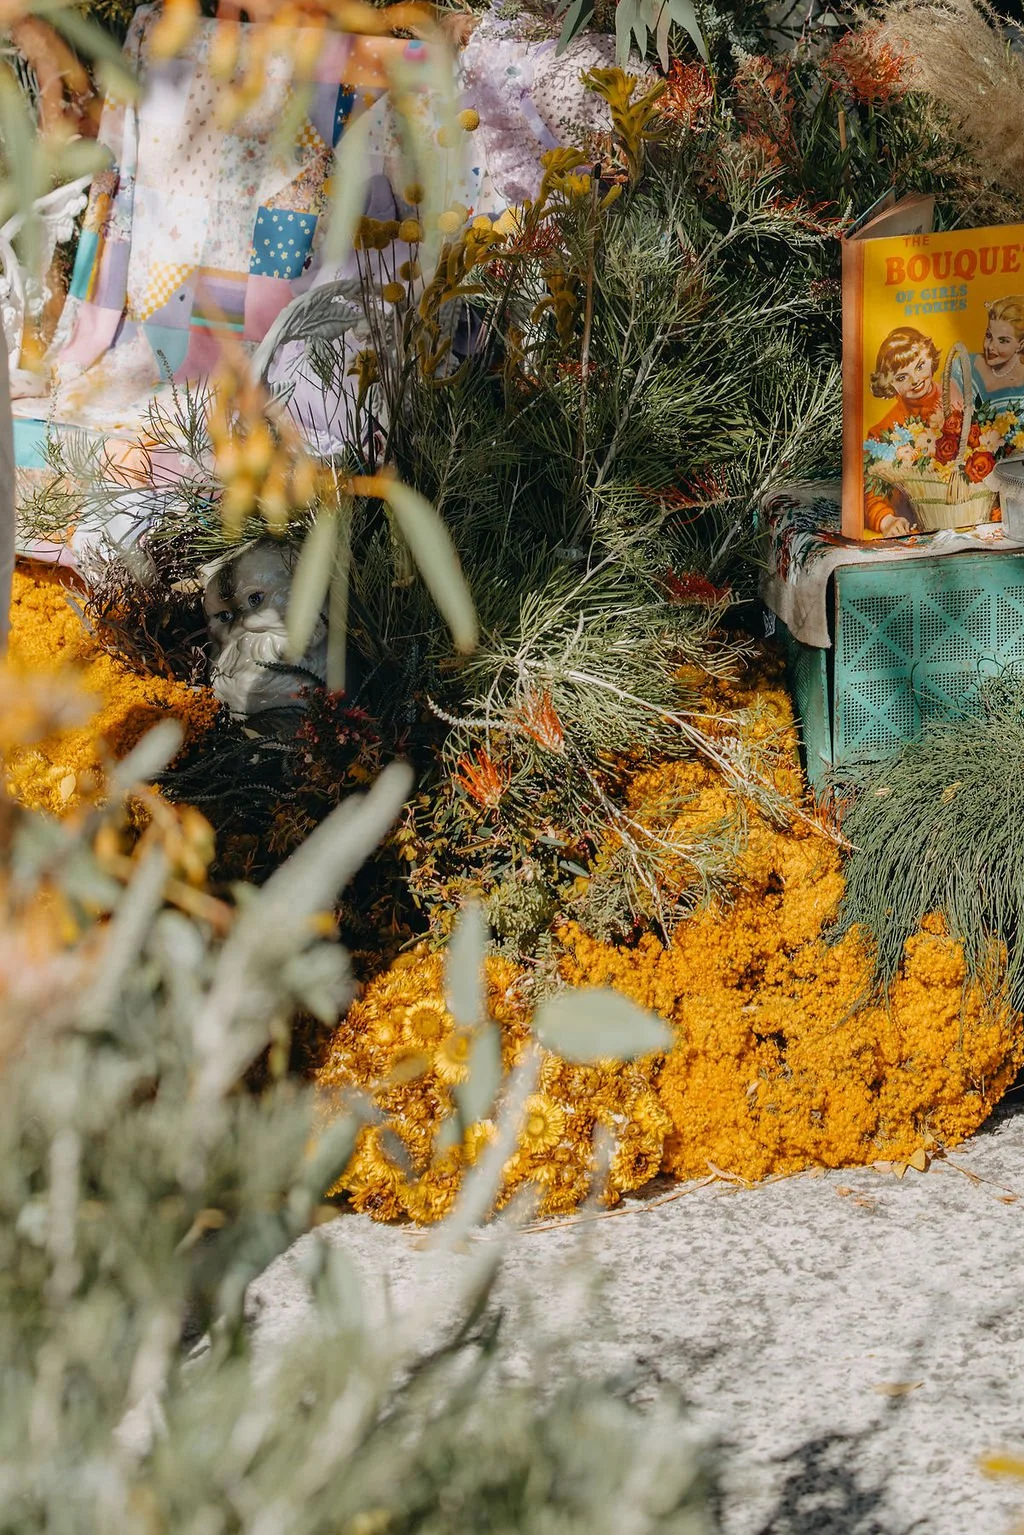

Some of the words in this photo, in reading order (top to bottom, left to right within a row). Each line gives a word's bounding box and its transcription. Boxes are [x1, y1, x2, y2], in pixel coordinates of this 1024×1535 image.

[903, 235, 930, 247] THE
[896, 290, 915, 303] OF
[920, 284, 968, 300] GIRLS
[904, 298, 968, 317] STORIES
